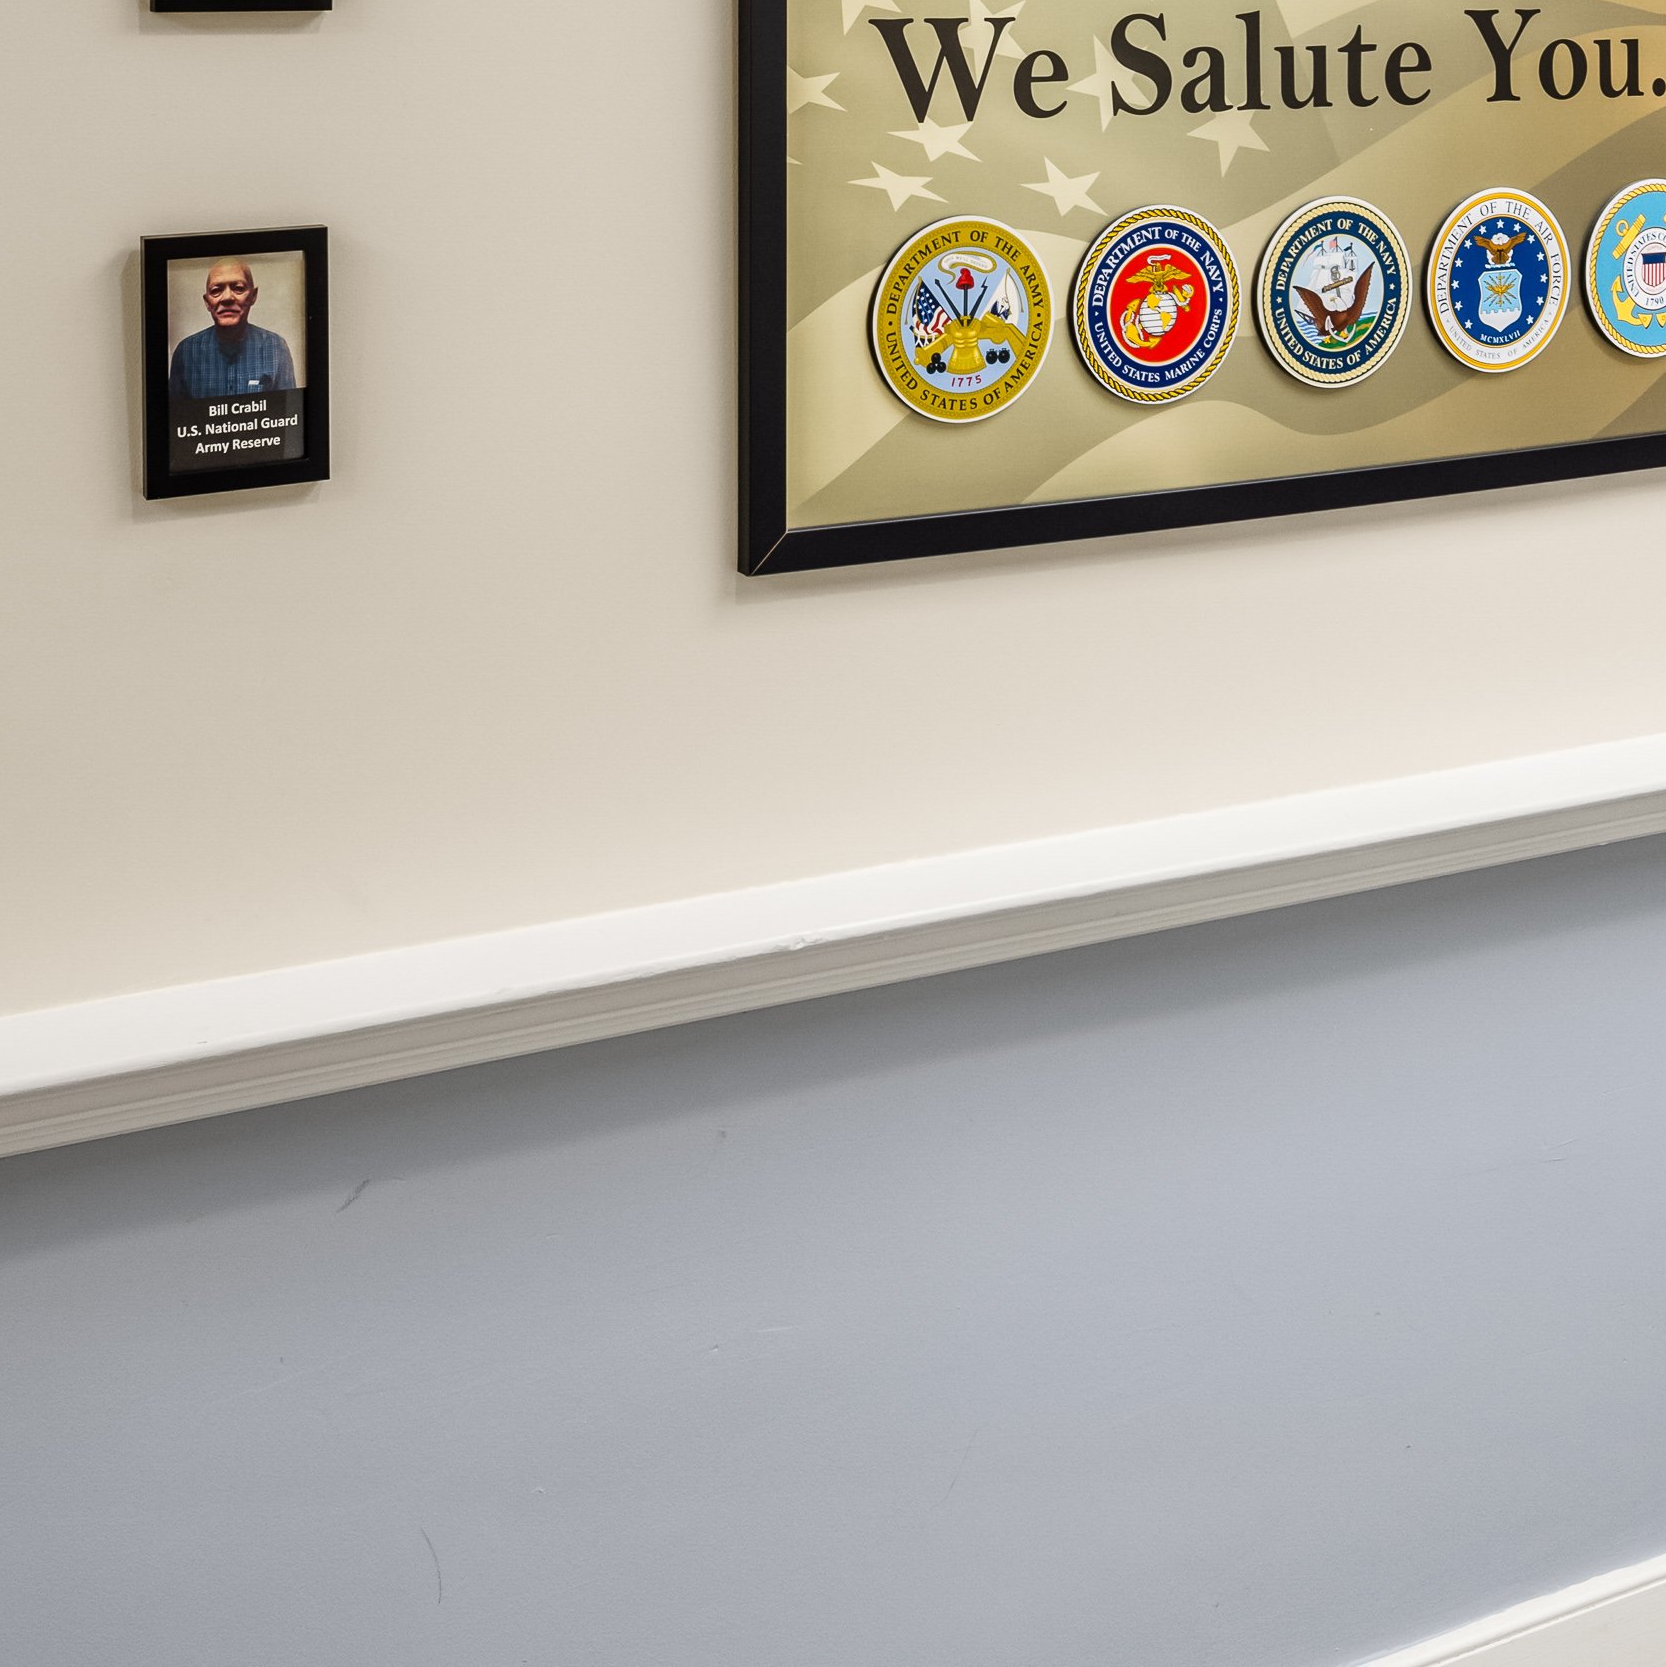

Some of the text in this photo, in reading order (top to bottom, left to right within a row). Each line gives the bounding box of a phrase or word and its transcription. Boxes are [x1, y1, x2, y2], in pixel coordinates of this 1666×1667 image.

[867, 16, 1071, 123] We
[1109, 9, 1433, 117] Salute
[887, 231, 961, 315] DEPARTMENT
[970, 230, 988, 243] OF
[994, 236, 1022, 262] THE
[1020, 264, 1044, 309] ARMY
[1092, 227, 1224, 307] DEPARTMENT OF THE NAVY
[1276, 218, 1396, 291] DEPARTMENT OF THE NAVY
[1437, 201, 1562, 314] DEPARTMENT OF THE AIR FORCE
[1630, 232, 1657, 256] STATES
[1626, 257, 1639, 297] UNITED
[1094, 309, 1222, 383] UNITED STATES MARINE CORPS
[1275, 297, 1397, 370] UNITED STATES OF AMERICA
[1449, 318, 1550, 360] UNITED STATES OF AMERICA
[1480, 330, 1521, 344] MCMXLVII
[886, 321, 1044, 411] UNITED STATES OF AMERICA
[951, 374, 982, 387] 1775
[177, 414, 298, 438] U.S. National Guard
[208, 399, 267, 417] Bill Crabil
[195, 436, 281, 454] Army Reserve
